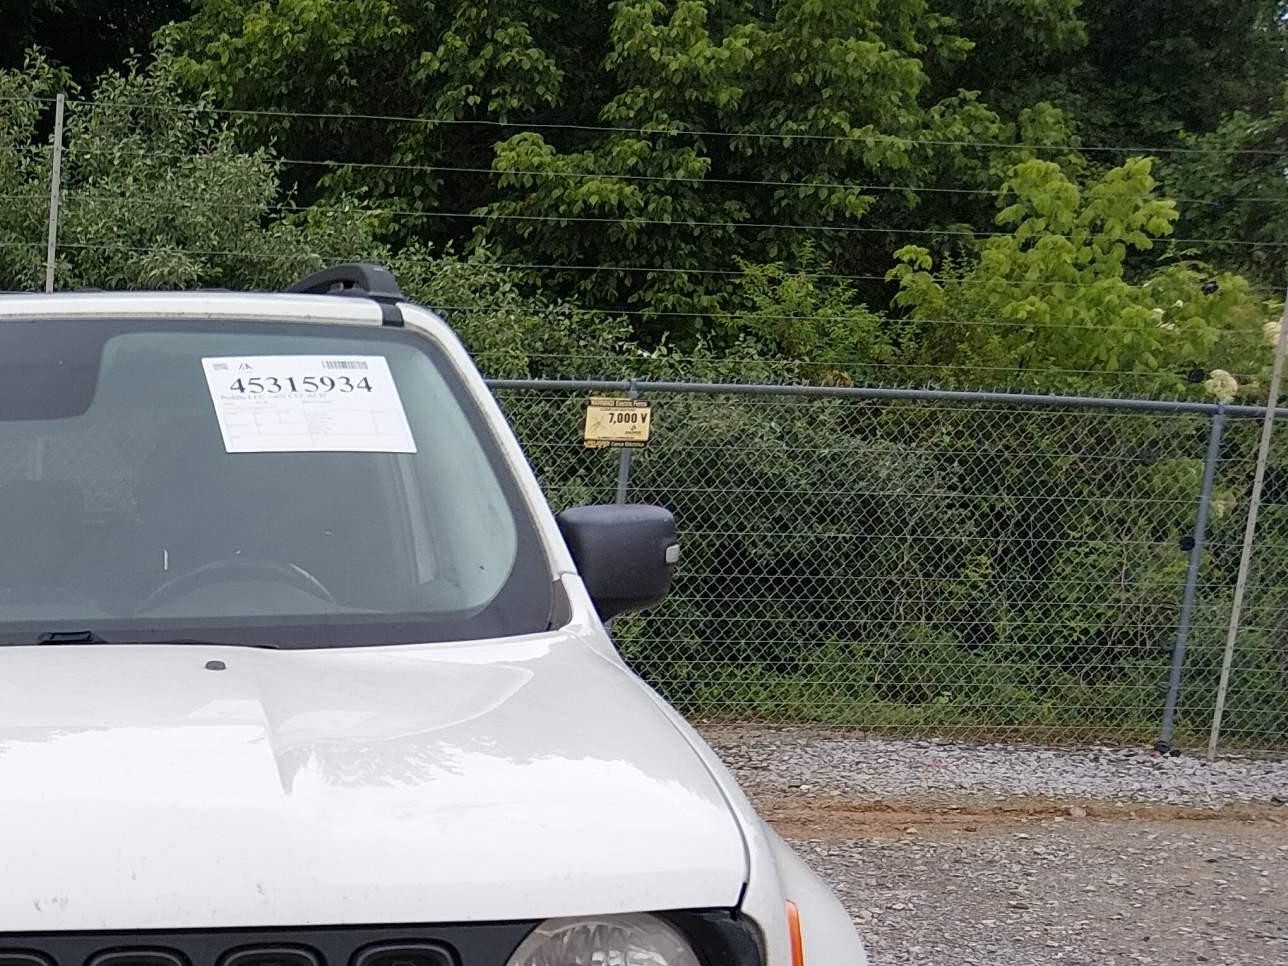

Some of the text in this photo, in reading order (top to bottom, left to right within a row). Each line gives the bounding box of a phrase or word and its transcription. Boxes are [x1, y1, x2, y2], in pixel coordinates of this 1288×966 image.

[230, 376, 373, 394] 45315934
[608, 412, 648, 425] 7,000 V
